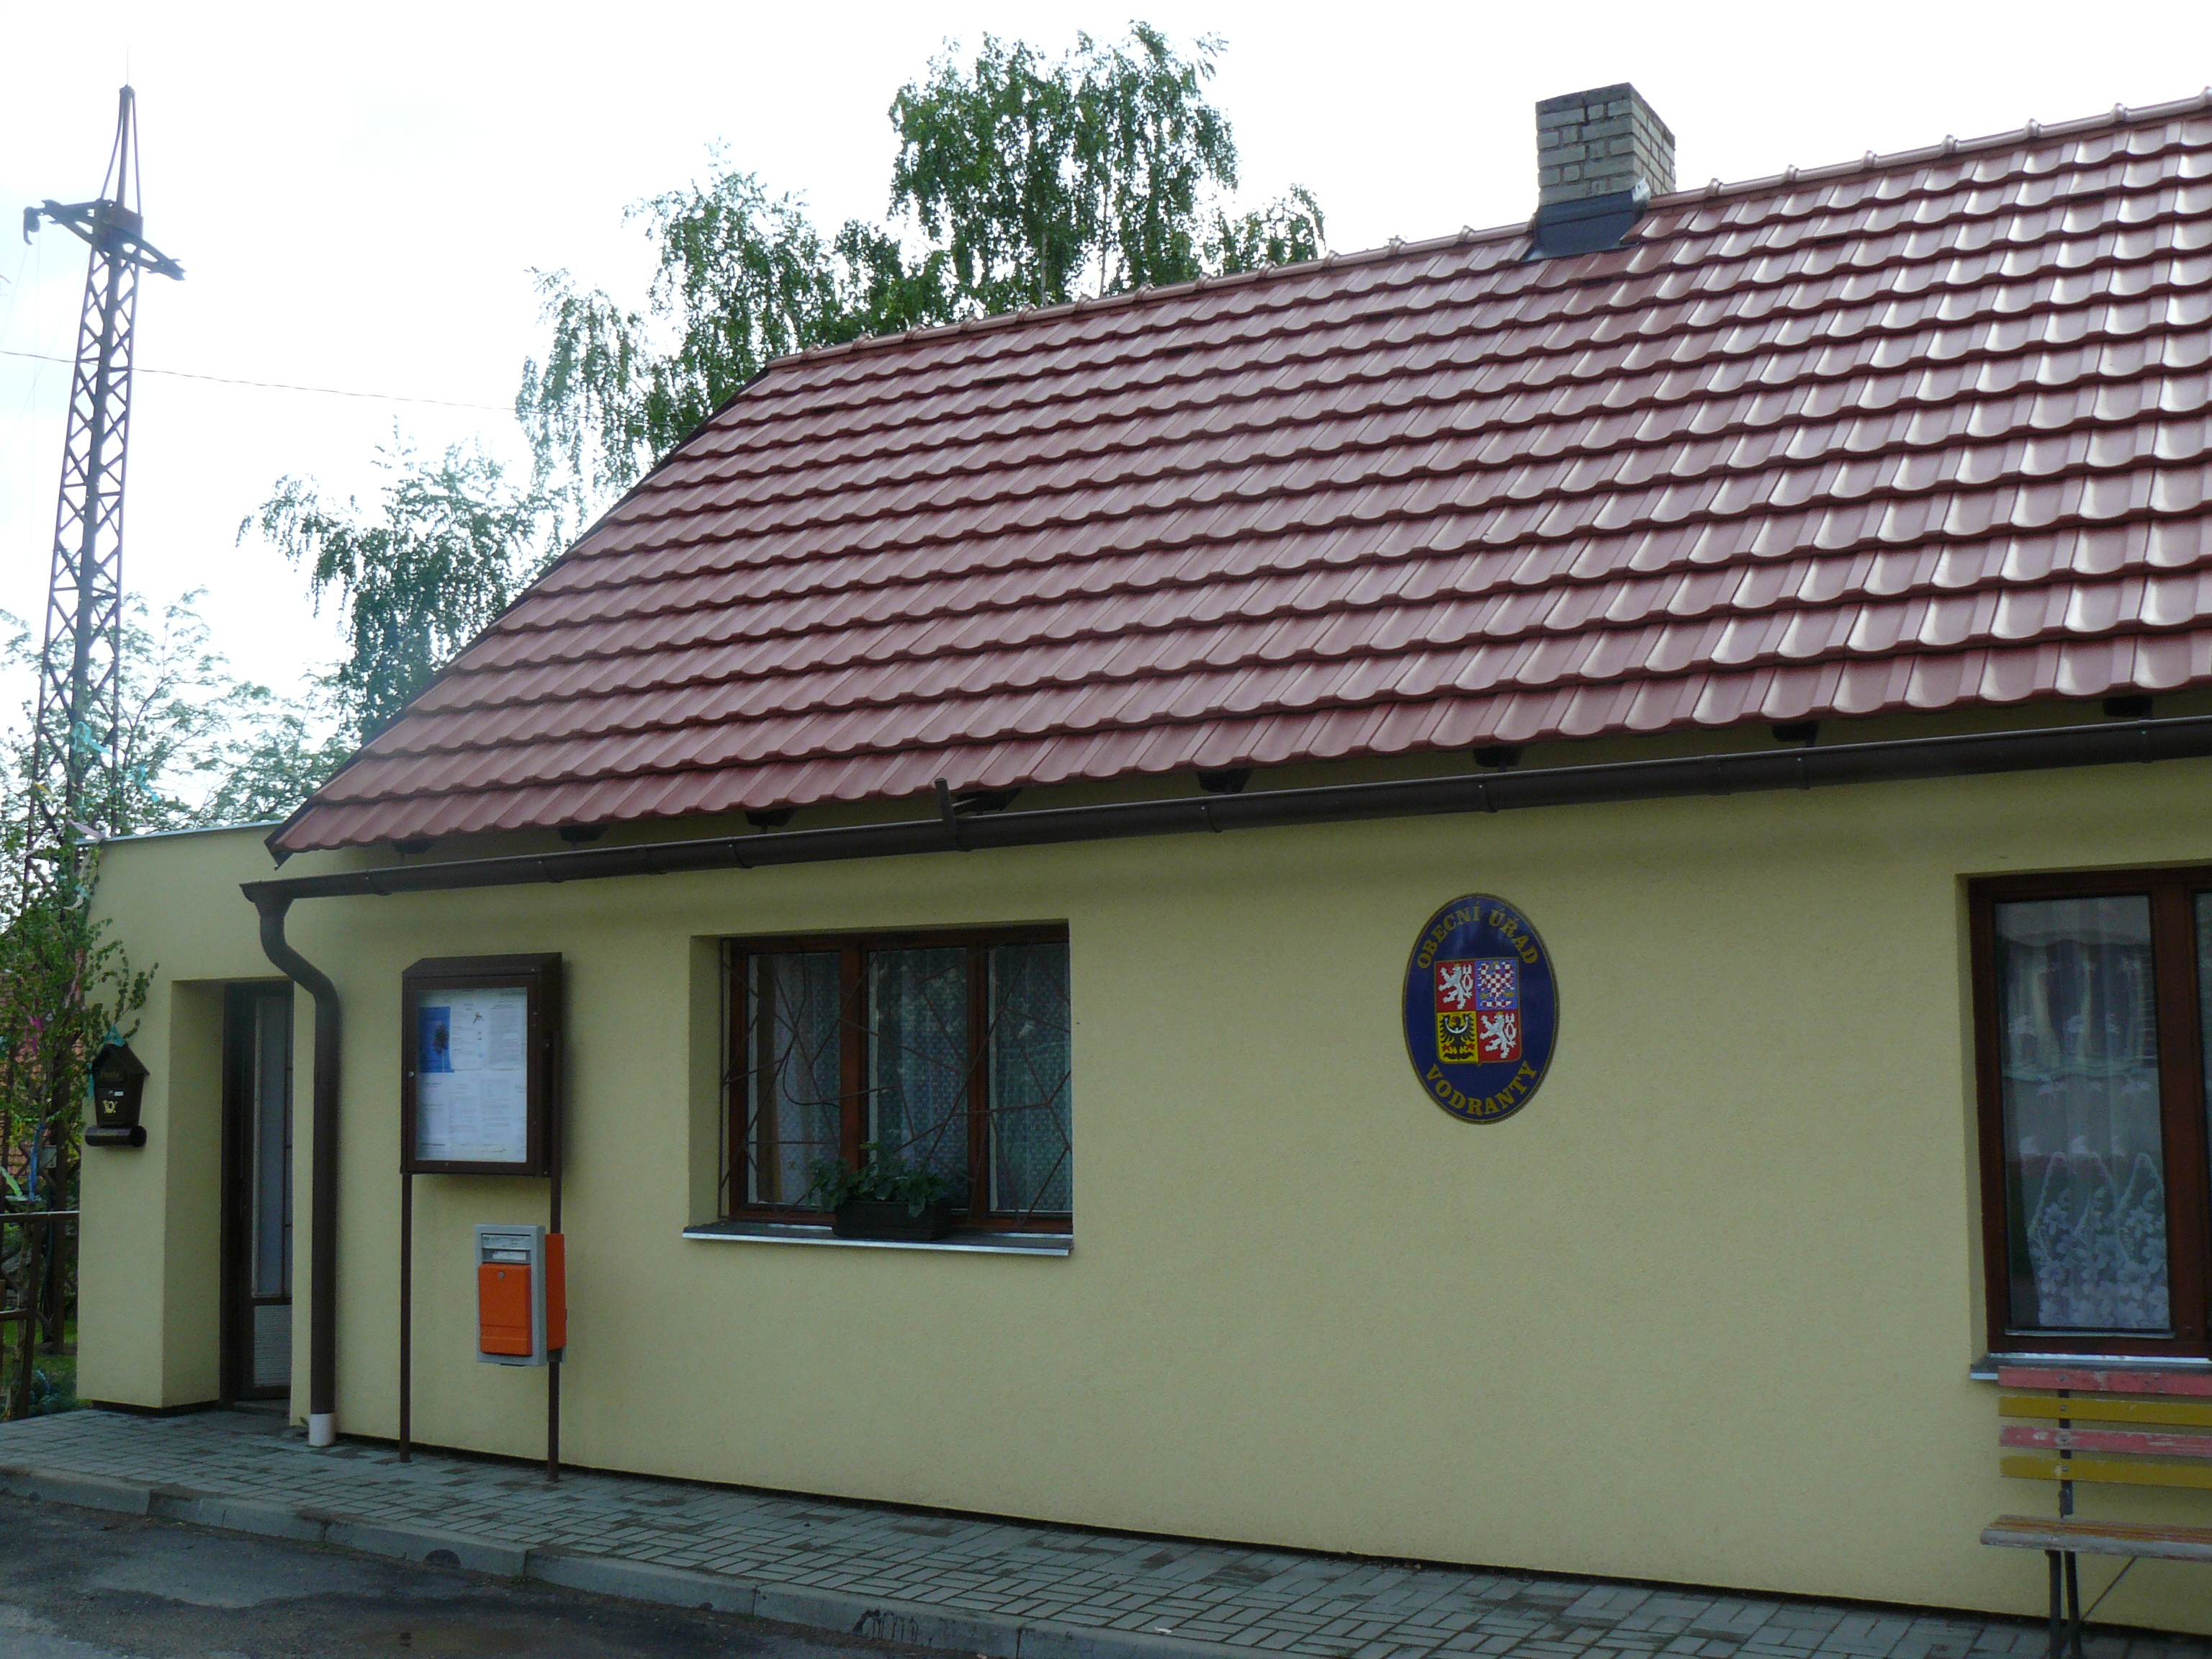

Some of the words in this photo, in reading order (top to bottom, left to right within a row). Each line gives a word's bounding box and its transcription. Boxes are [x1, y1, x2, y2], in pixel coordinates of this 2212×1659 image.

[1416, 900, 1480, 968] OBECNÍ
[1488, 908, 1539, 964] ÚŘAD
[1426, 1061, 1537, 1116] VODRANTY
